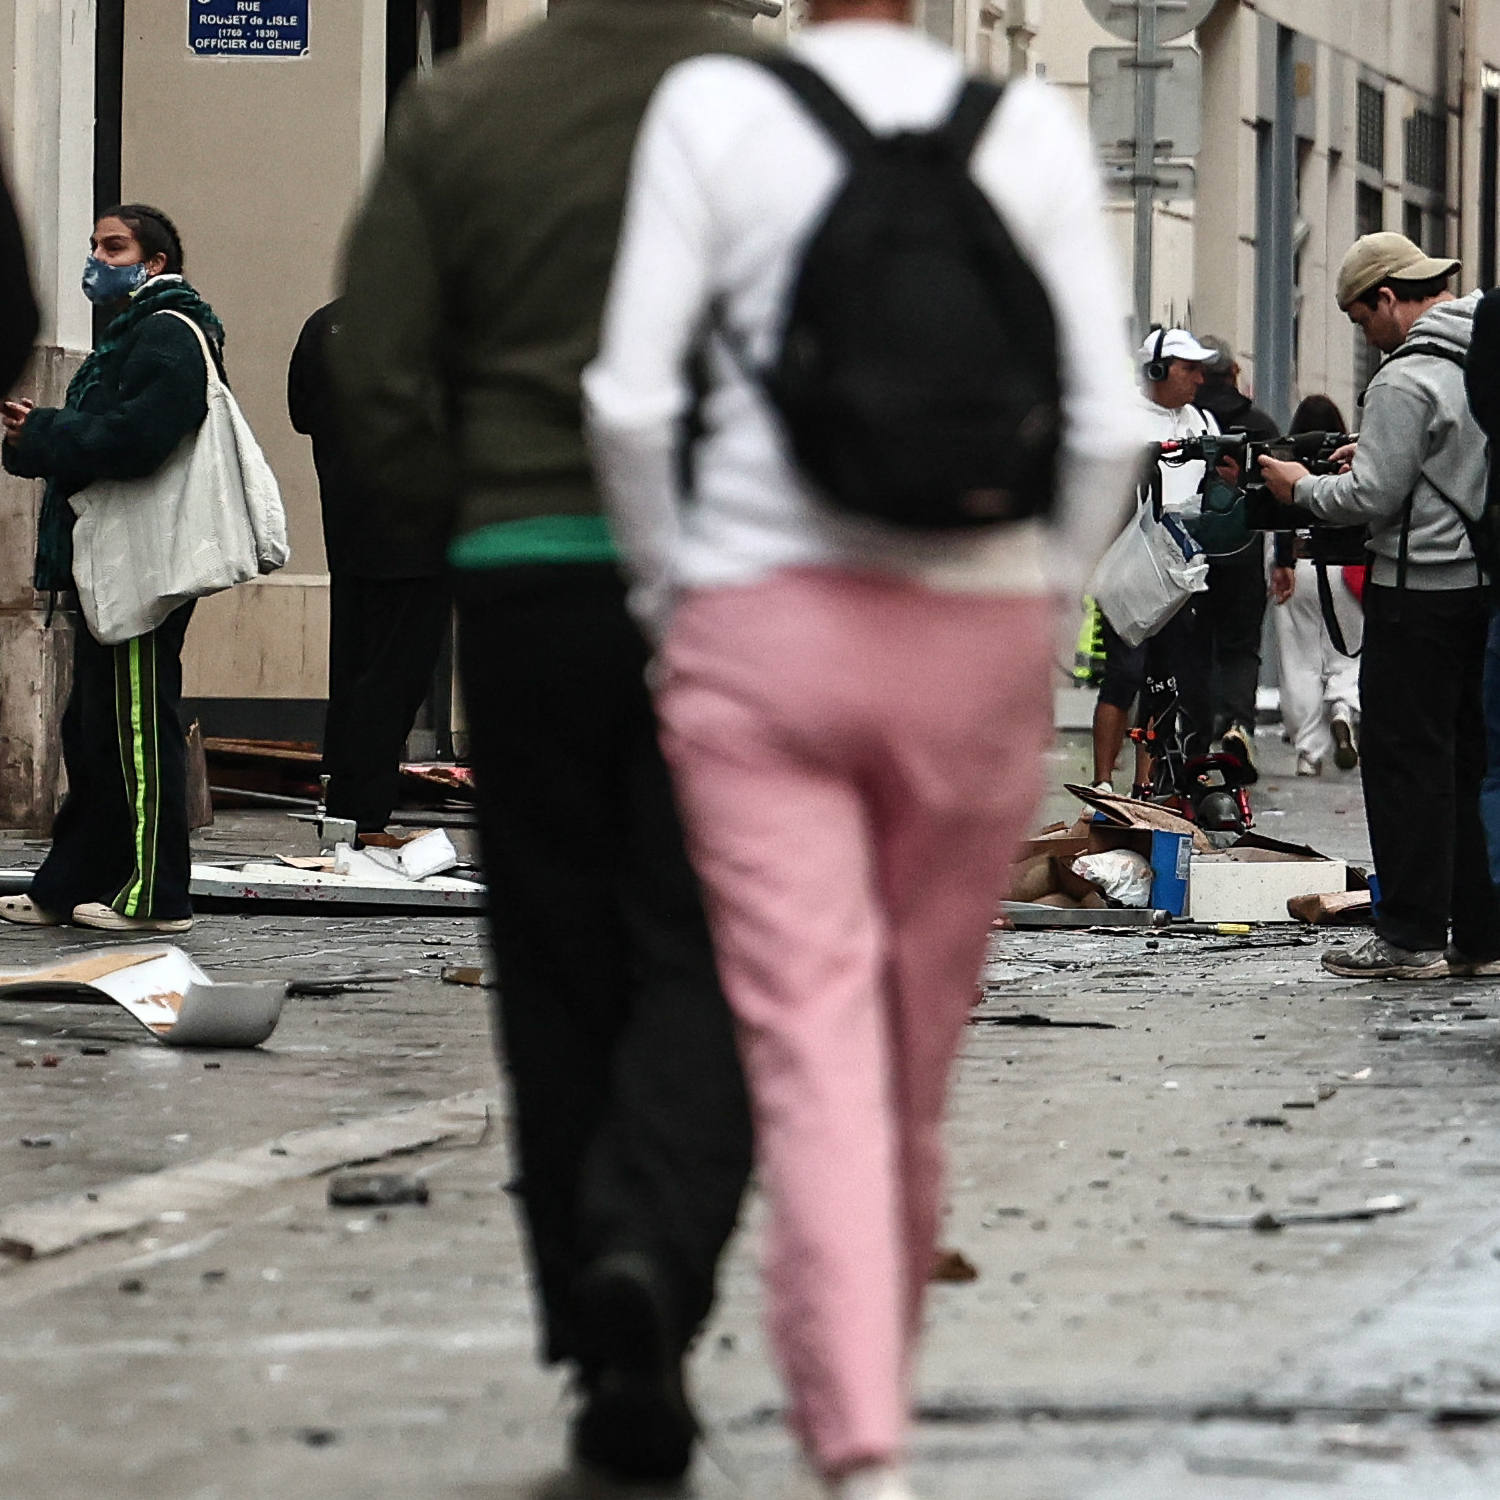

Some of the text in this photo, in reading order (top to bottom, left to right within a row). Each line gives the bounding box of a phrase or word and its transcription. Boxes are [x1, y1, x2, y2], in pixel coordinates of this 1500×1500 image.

[236, 1, 261, 12] RUE
[250, 15, 263, 26] de
[195, 38, 247, 50] OFFICIER
[250, 39, 264, 50] du
